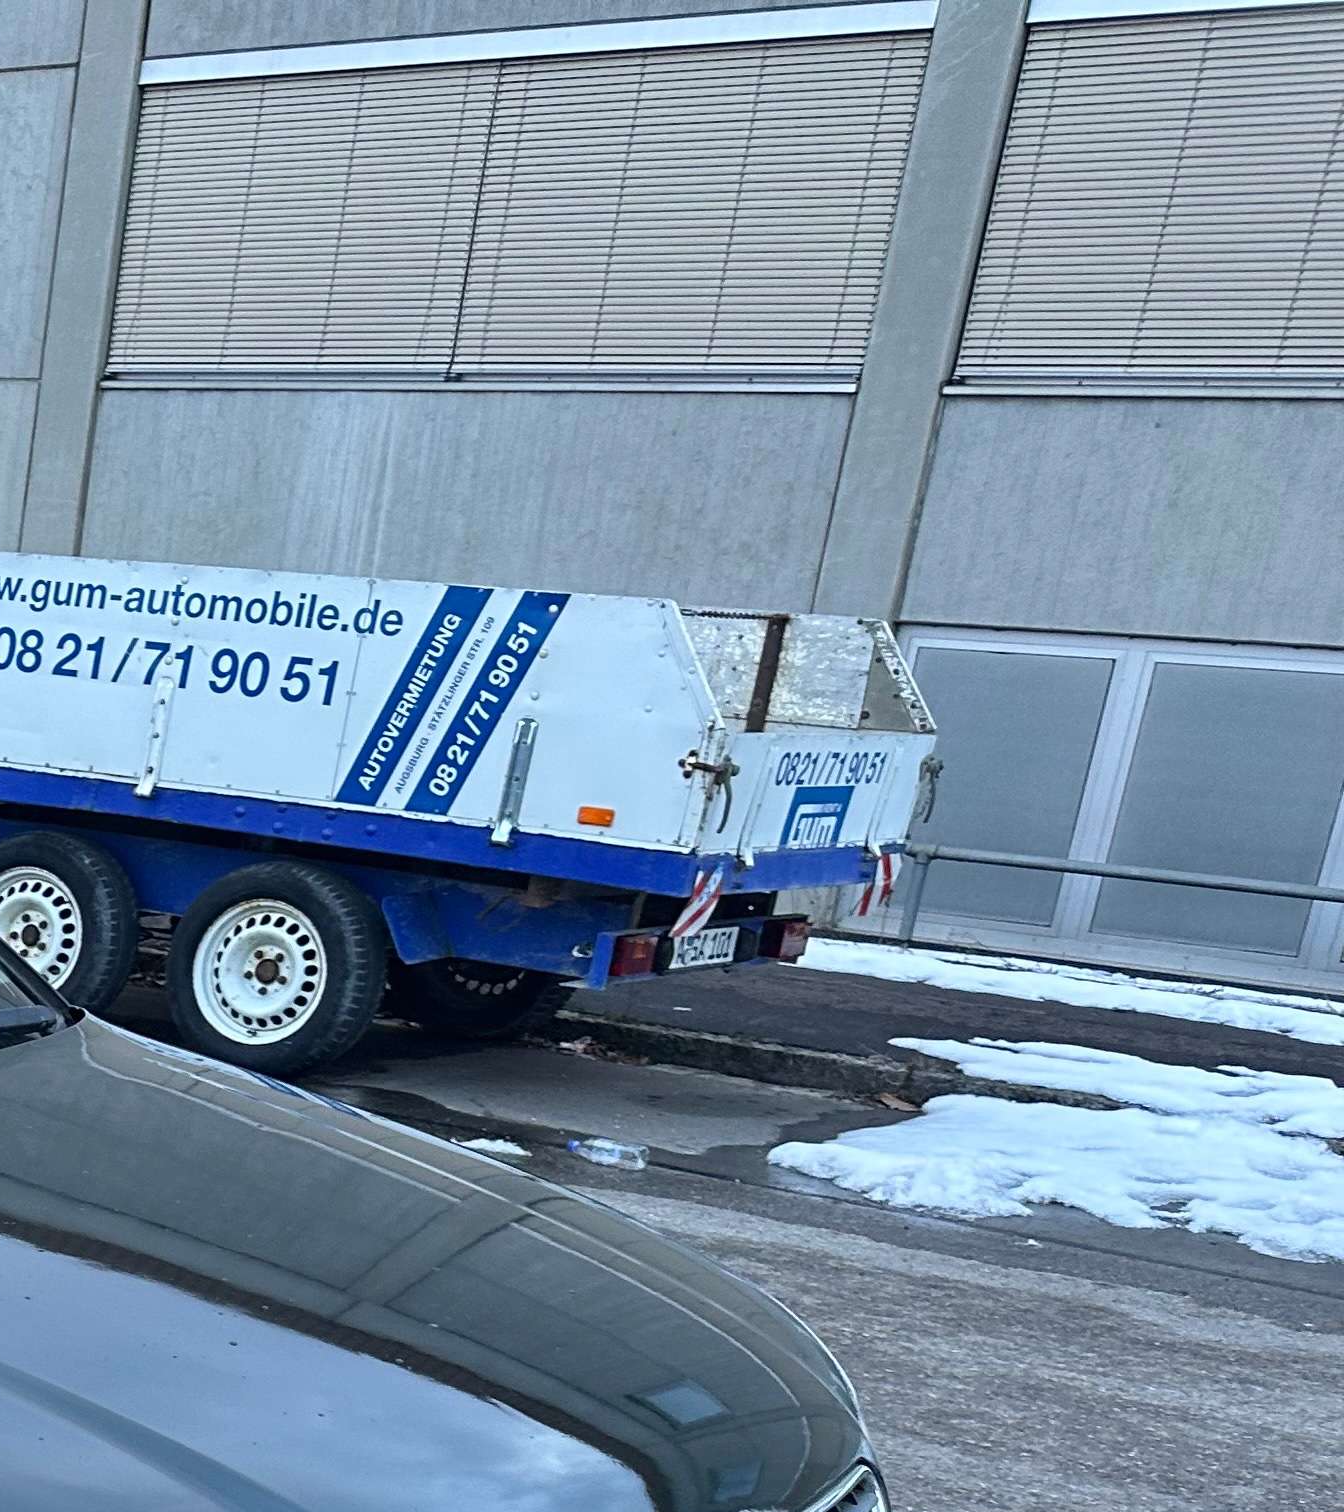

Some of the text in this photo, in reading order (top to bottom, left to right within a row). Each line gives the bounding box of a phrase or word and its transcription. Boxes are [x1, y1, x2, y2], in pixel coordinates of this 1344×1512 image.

[208, 648, 271, 697] 90
[279, 655, 340, 706] 51
[357, 613, 463, 791] AUTOVERMIETUNG
[395, 737, 429, 794] AUGSBURG
[481, 616, 495, 635] 109
